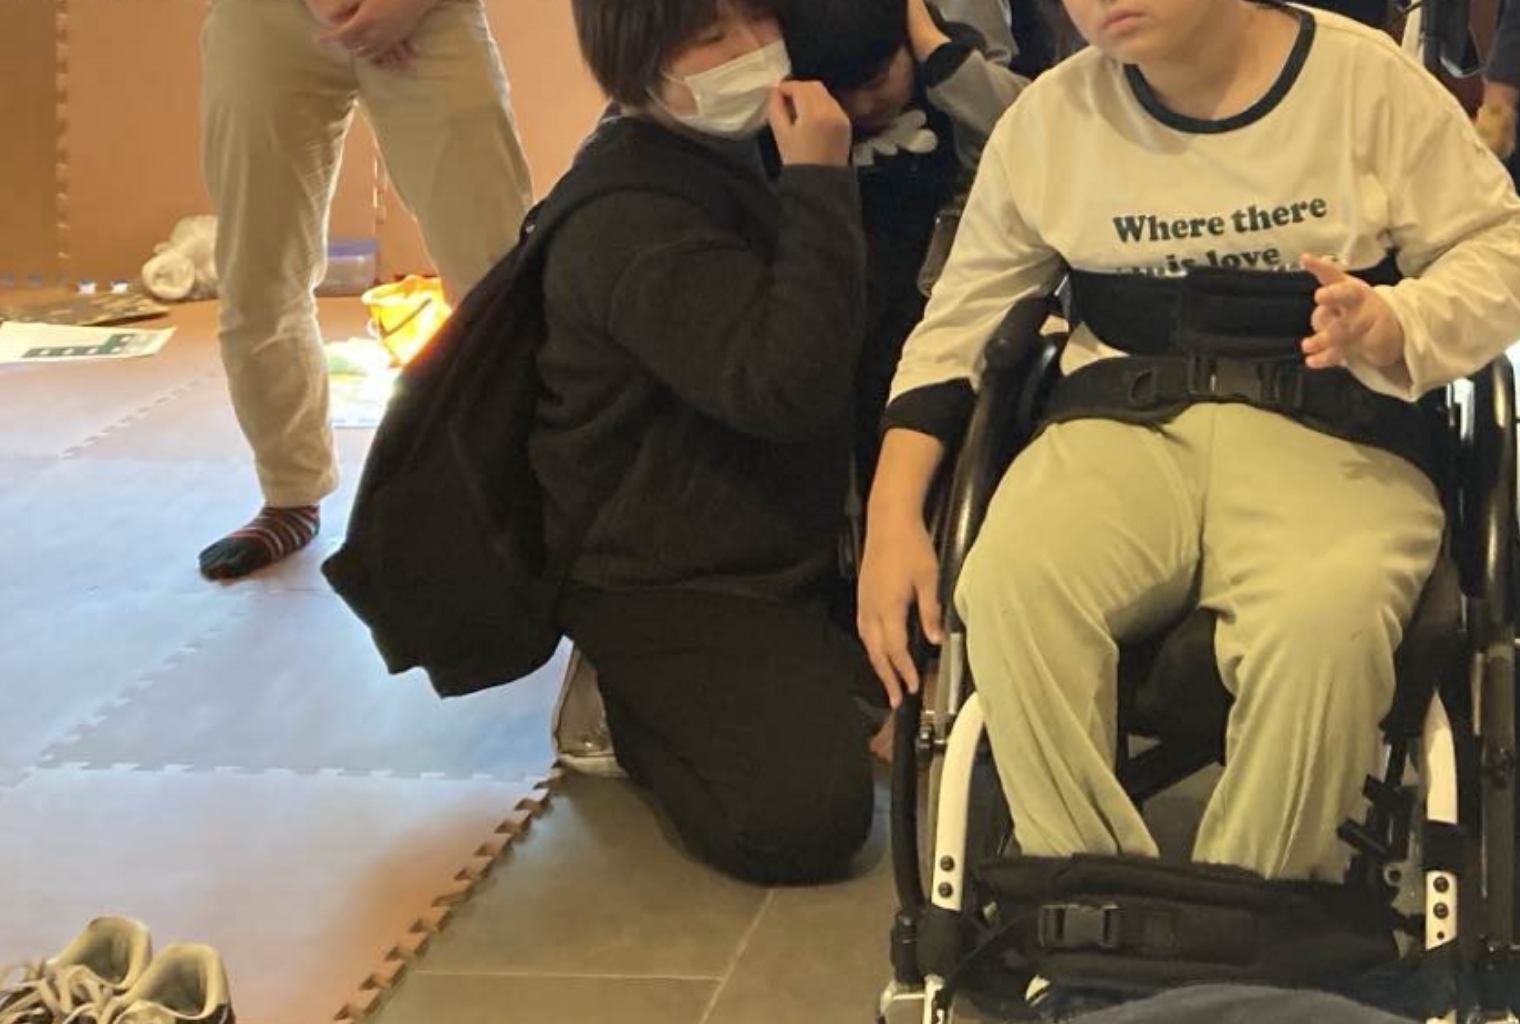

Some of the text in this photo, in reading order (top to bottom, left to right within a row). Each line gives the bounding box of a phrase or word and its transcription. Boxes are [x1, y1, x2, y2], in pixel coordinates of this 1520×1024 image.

[1113, 198, 1327, 243] Where there
[1205, 247, 1279, 269] love
